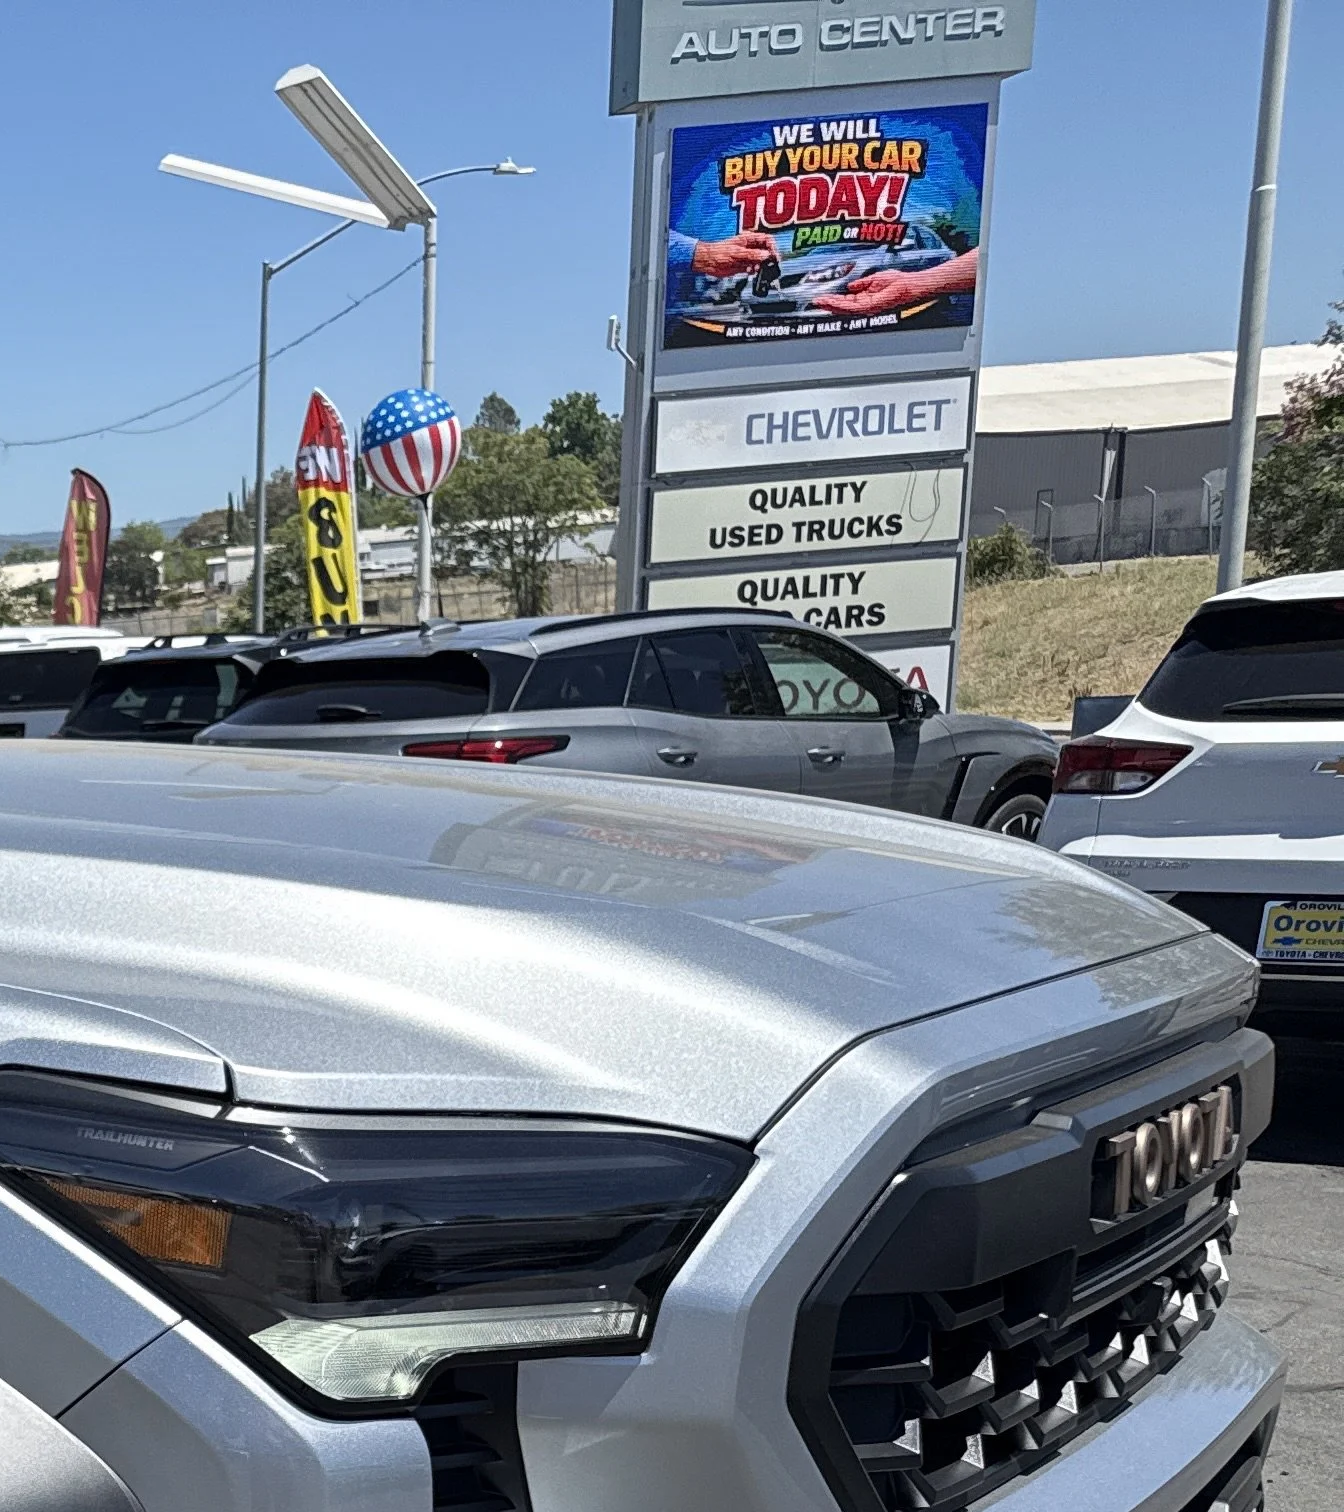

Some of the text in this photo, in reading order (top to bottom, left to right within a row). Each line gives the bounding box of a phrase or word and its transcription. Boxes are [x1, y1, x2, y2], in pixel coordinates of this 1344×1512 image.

[670, 5, 1005, 64] AUTO CENTER
[773, 118, 881, 146] WE WILL
[724, 140, 922, 187] BUY YOUR CAR
[735, 173, 908, 232] TODAY!
[795, 223, 905, 248] PAID OR NOT!
[726, 327, 744, 337] ANY
[746, 326, 790, 338] CONDITION
[796, 324, 814, 335] ANY
[849, 319, 868, 331] ANY
[870, 314, 899, 327] MODEL
[745, 398, 952, 446] CHEVROLET
[748, 480, 868, 514] QUALITY
[709, 513, 904, 549] USED TRUCKS
[737, 571, 866, 606] QUALITY
[803, 602, 886, 630] CARS
[76, 1126, 175, 1151] TRAILHUNTER
[1105, 1085, 1235, 1216] TOYOTA
